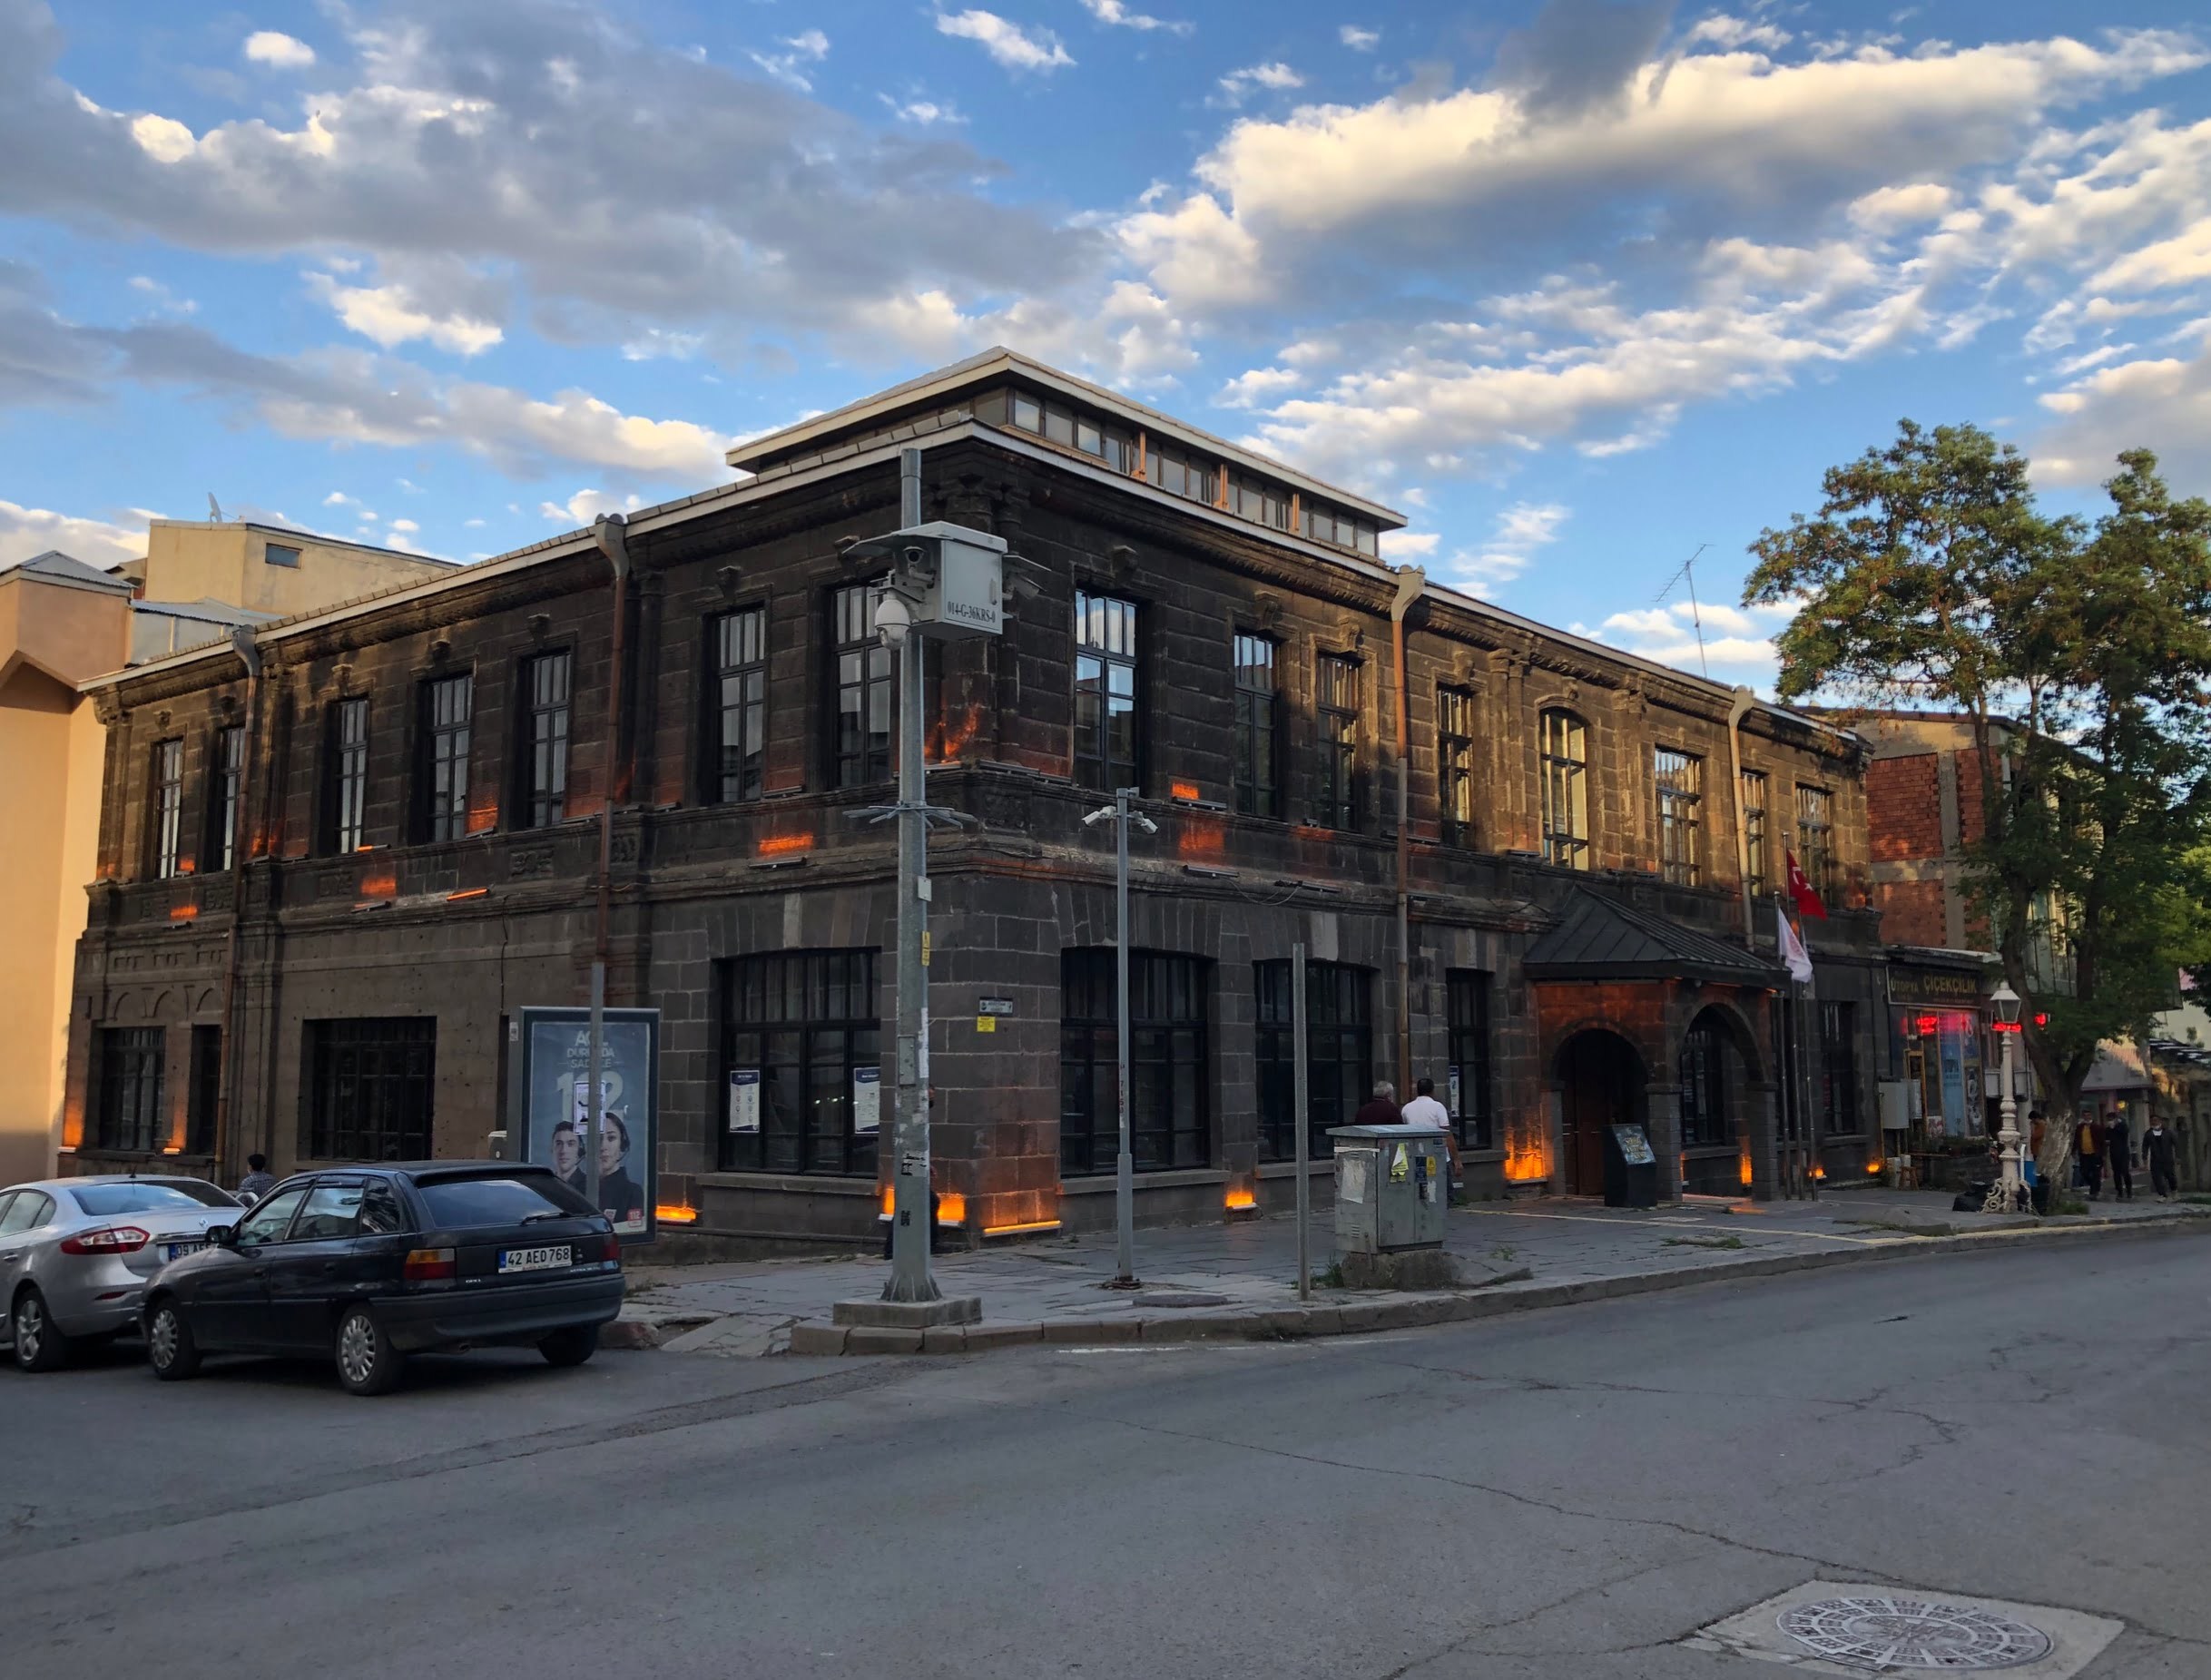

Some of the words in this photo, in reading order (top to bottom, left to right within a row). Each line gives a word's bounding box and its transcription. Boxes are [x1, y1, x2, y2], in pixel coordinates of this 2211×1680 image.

[567, 1047, 614, 1058] DURDA
[508, 1253, 523, 1266] 42
[526, 1250, 547, 1264] AED
[549, 1247, 570, 1262] 768
